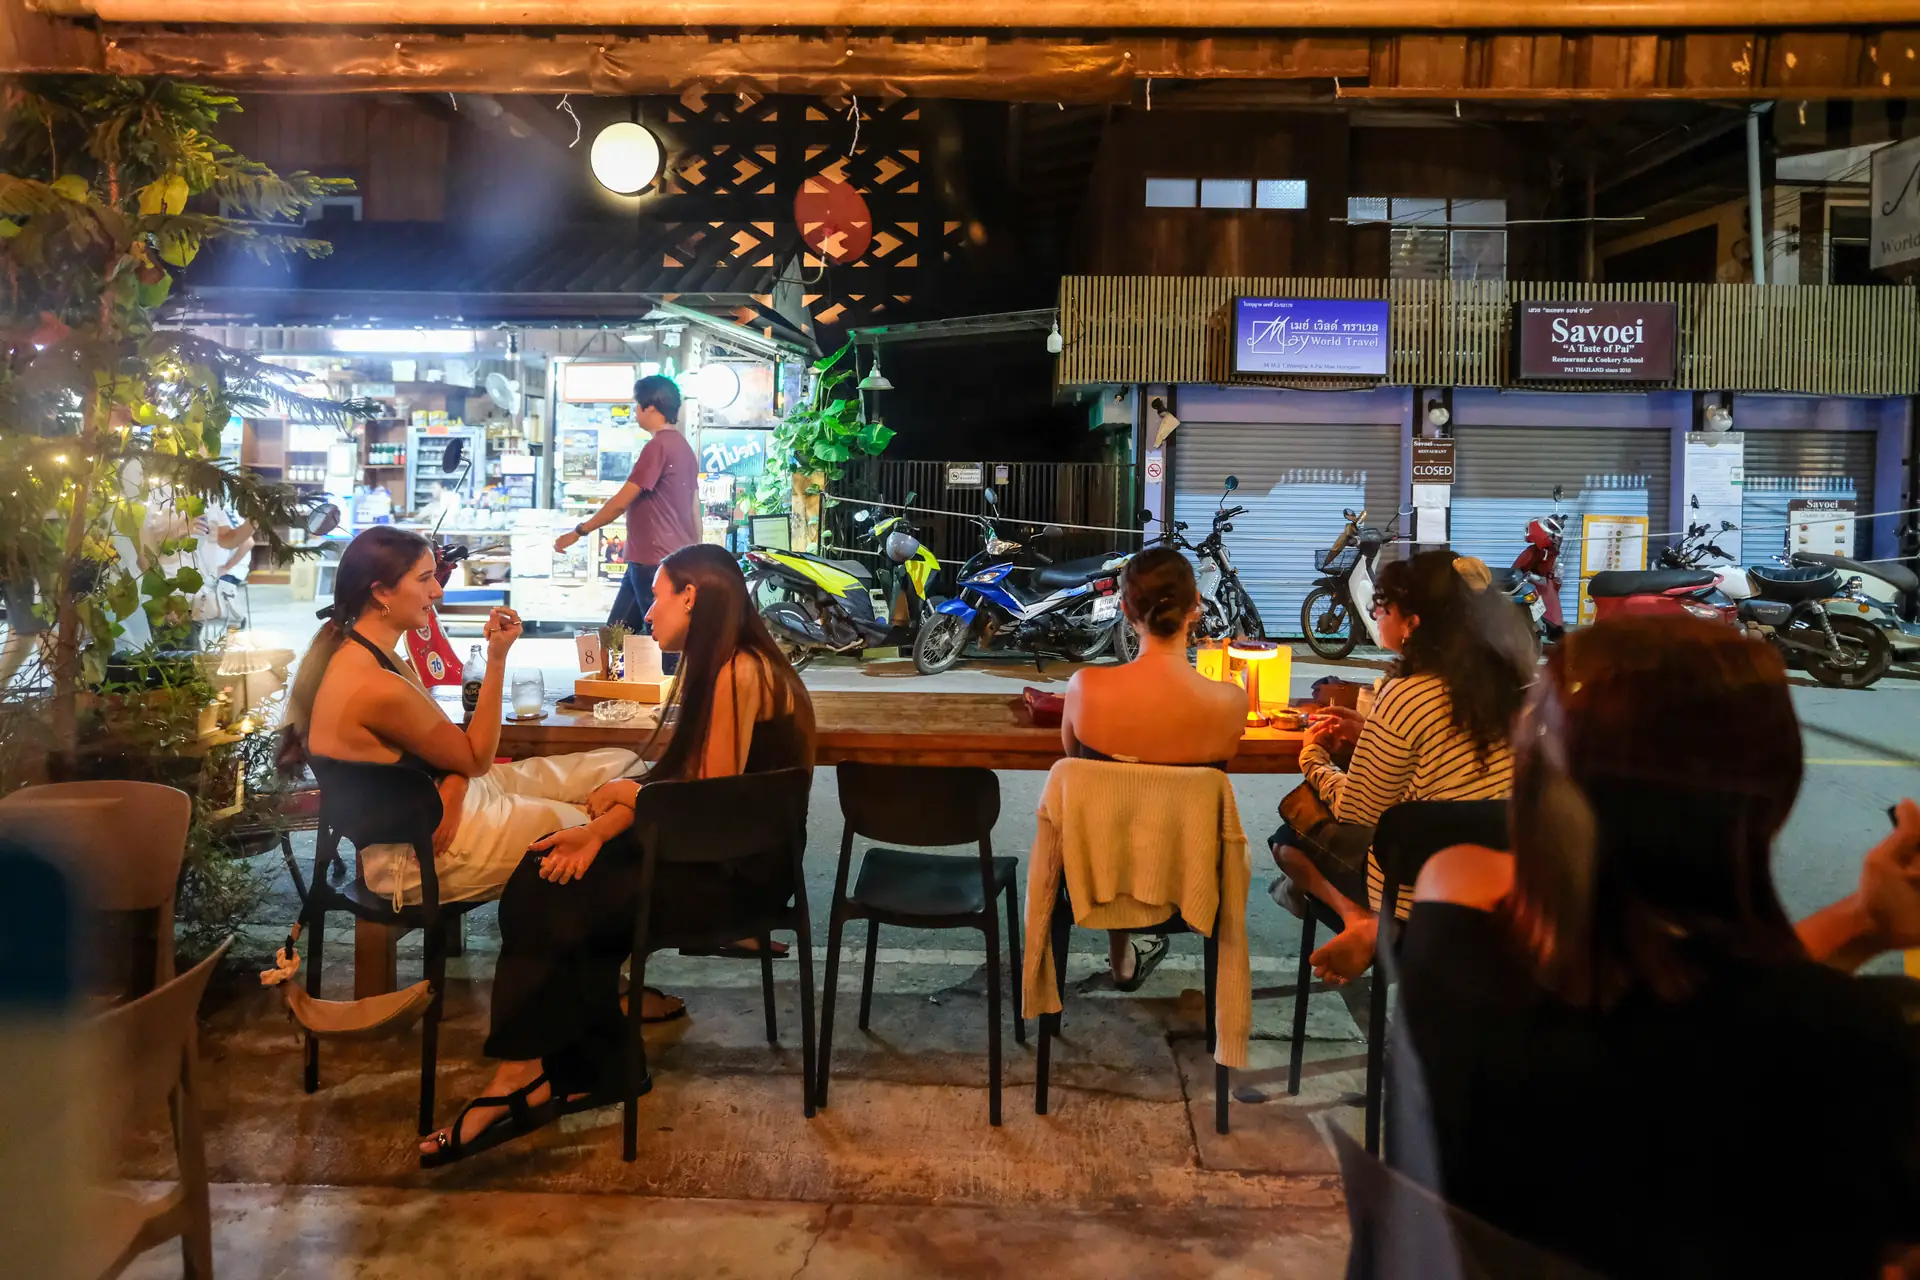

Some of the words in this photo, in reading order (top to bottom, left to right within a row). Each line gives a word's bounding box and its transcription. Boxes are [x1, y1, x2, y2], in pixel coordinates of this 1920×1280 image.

[1290, 318, 1310, 331] เมย์
[1313, 319, 1339, 331] เวิลด์
[1342, 322, 1379, 332] ทราเวล
[1551, 317, 1644, 343] Savoei
[1311, 336, 1341, 346] World
[1346, 337, 1378, 347] Travel
[1577, 344, 1601, 353] Taste
[1603, 344, 1613, 353] of
[1595, 357, 1621, 365] Cookery
[1413, 465, 1453, 476] CLOSED
[1806, 500, 1839, 508] Savoei
[1207, 574, 1219, 595] HONDA
[585, 650, 595, 664] 8
